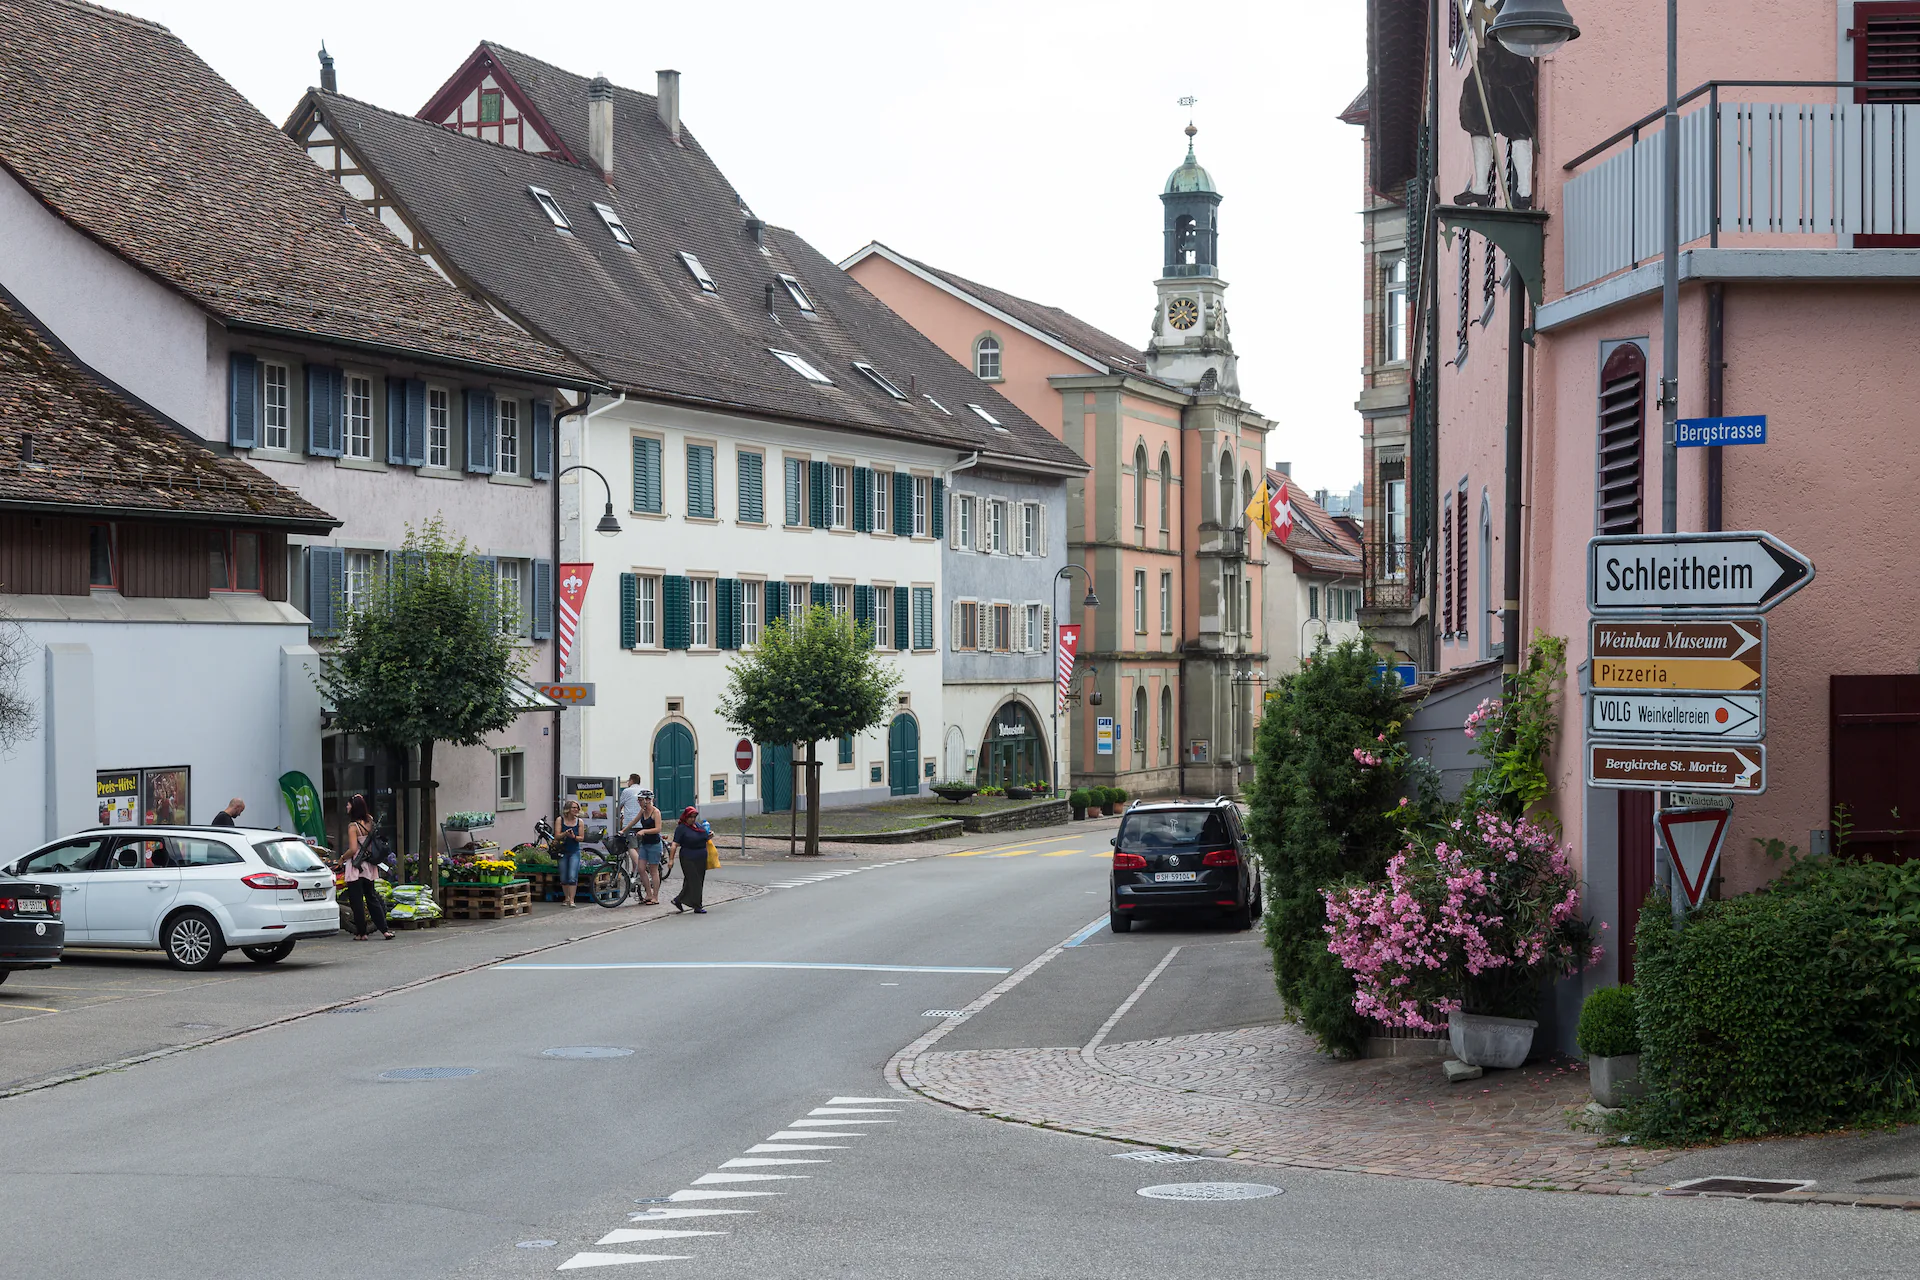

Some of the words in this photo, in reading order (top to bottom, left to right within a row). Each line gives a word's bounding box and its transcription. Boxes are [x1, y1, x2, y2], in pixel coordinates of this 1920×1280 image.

[1680, 423, 1762, 445] Bergstrasse
[1606, 556, 1753, 591] Schleitheim
[1599, 631, 1661, 649] Weinbau
[1664, 632, 1728, 649] Museum
[1602, 664, 1668, 683] Pizzeria
[1600, 701, 1631, 722] VOLG
[1638, 705, 1710, 724] Weinkellereien
[1605, 758, 1667, 772] Bergkirche
[1669, 761, 1686, 772] St.
[1688, 761, 1728, 773] Moritz
[97, 776, 136, 795] Preis-Hits!
[580, 791, 603, 799] Knaller
[1685, 796, 1724, 807] Waldpfad
